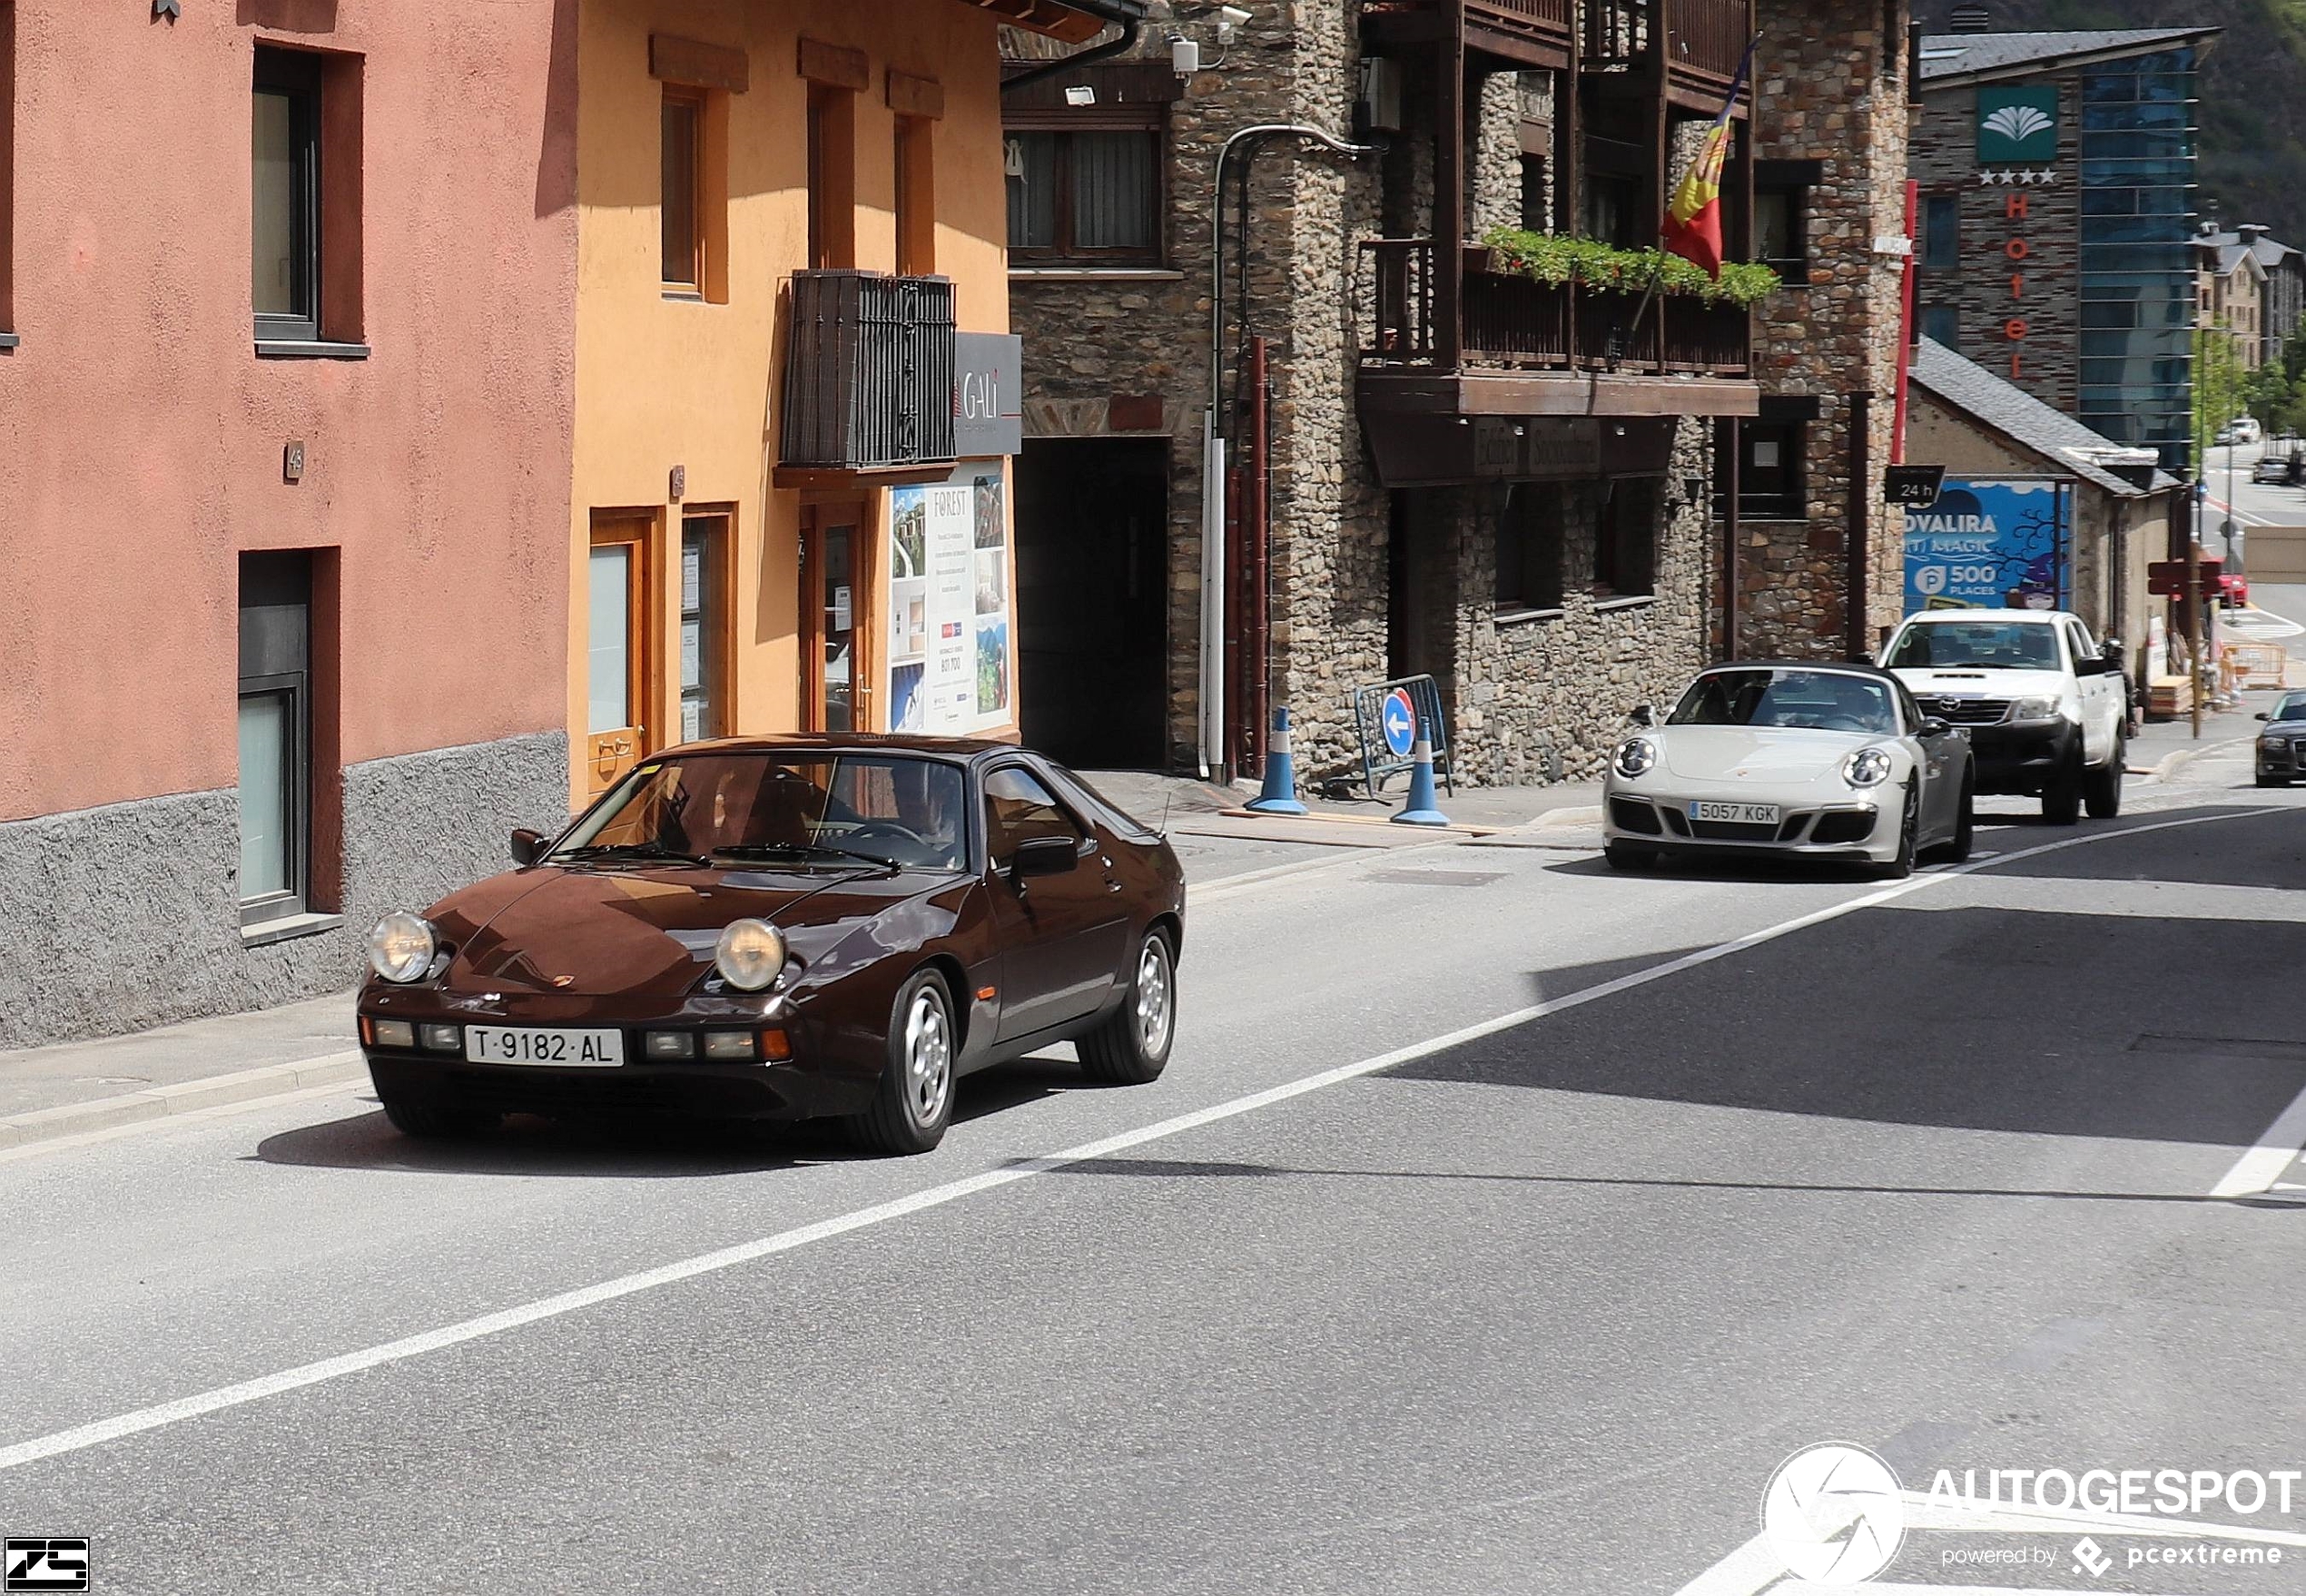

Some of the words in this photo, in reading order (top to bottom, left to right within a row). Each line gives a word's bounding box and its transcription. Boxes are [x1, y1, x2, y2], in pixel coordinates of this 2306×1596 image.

[2005, 193, 2028, 379] Hotel
[1900, 484, 1919, 497] 24
[1923, 484, 1933, 496] h
[934, 490, 966, 517] FOREST
[1950, 566, 1996, 584] 500
[1950, 586, 1996, 596] PLACES
[1700, 804, 1739, 819] 5057
[1745, 806, 1775, 821] KGK
